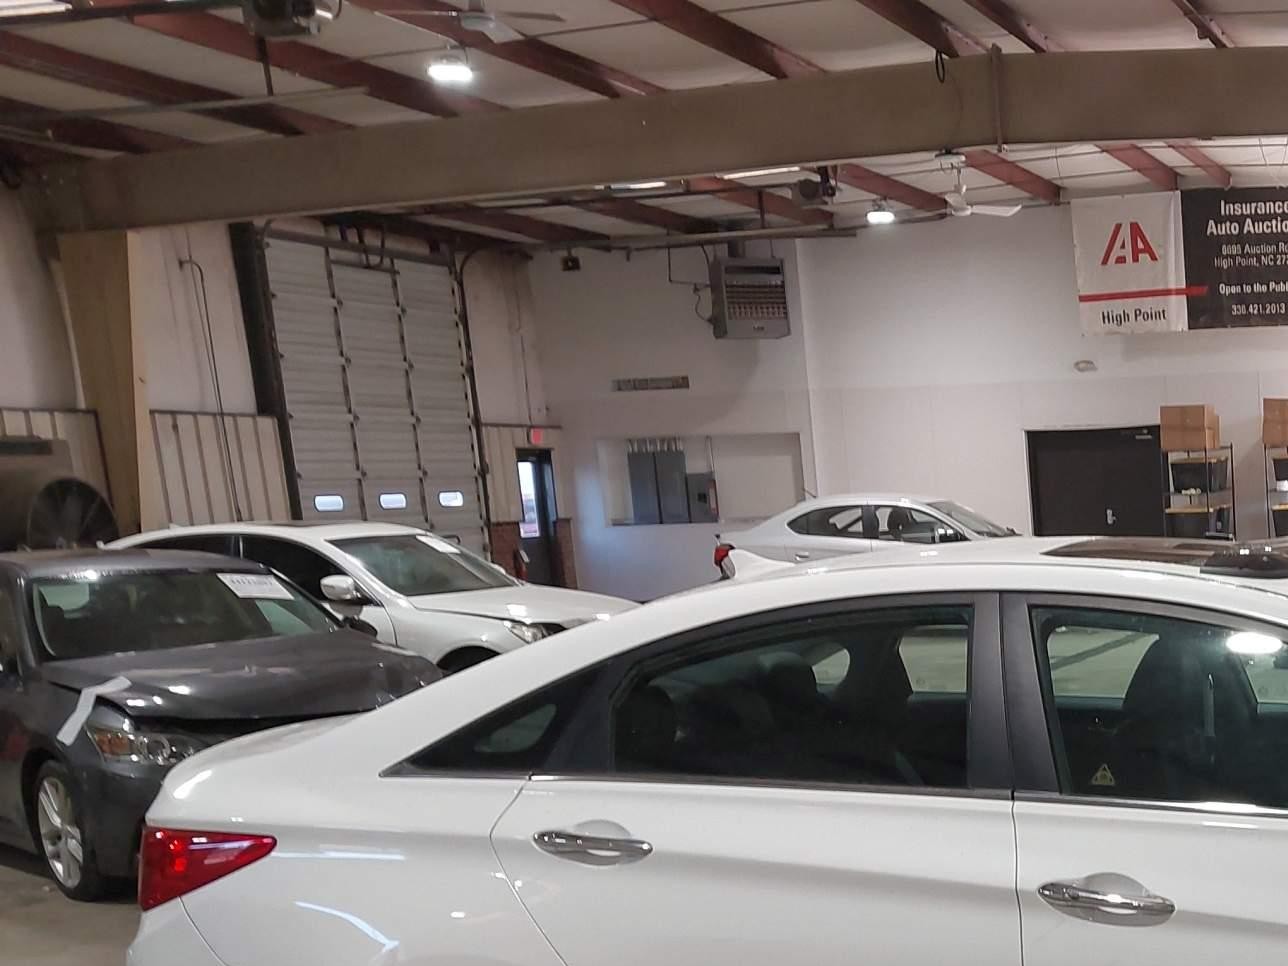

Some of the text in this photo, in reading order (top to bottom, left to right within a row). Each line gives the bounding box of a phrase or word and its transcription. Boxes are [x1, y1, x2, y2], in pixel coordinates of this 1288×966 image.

[1206, 219, 1239, 236] Auto
[1244, 242, 1276, 255] Auction
[1214, 256, 1233, 269] High
[1261, 255, 1275, 266] NC
[1219, 283, 1241, 296] Open
[1243, 284, 1252, 294] to
[1254, 282, 1267, 293] the
[1102, 306, 1166, 327] High Point
